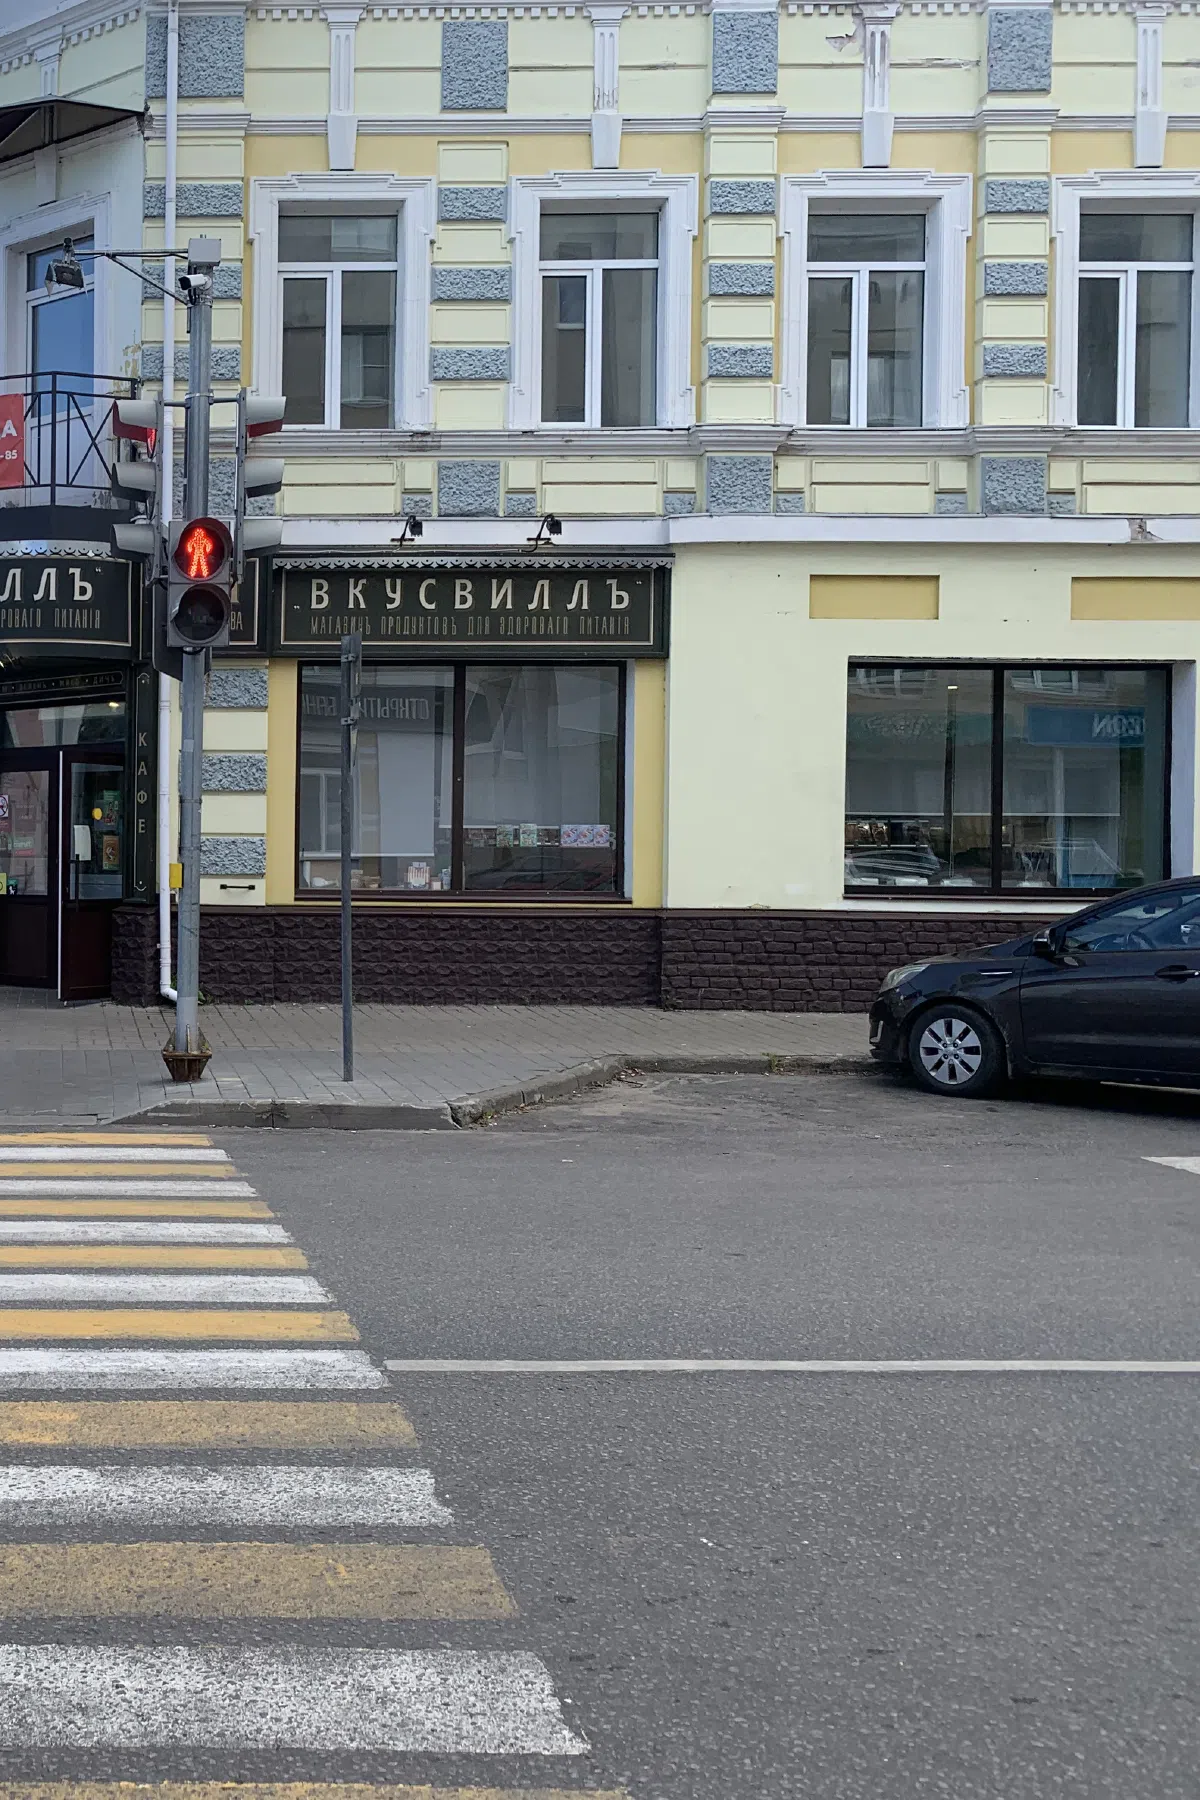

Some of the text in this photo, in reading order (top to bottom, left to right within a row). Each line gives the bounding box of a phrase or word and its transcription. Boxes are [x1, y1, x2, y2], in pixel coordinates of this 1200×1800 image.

[310, 616, 371, 635] МАГАЗИНЪ
[380, 616, 457, 636] ПРОДУКТОВЪ
[467, 616, 490, 636] ДЛЯ
[500, 616, 569, 636] ЗДОРОВАГО
[137, 731, 148, 834] КАФЕ
